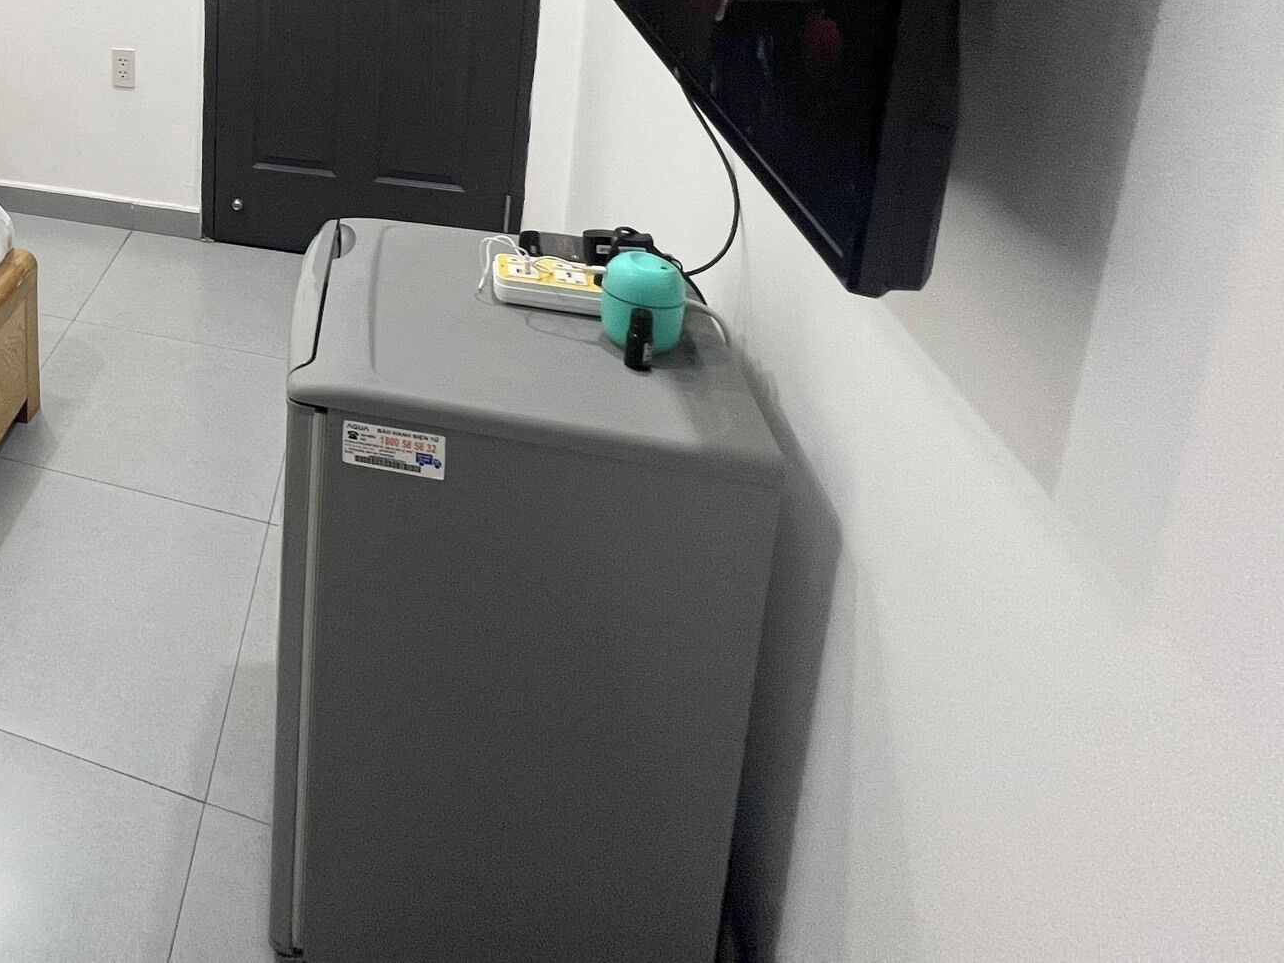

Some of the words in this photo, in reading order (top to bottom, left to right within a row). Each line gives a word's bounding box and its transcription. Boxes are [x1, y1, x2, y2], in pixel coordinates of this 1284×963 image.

[380, 435, 400, 448] 1800
[402, 438, 413, 450] 58
[414, 440, 425, 452] 58
[426, 443, 437, 454] 32
